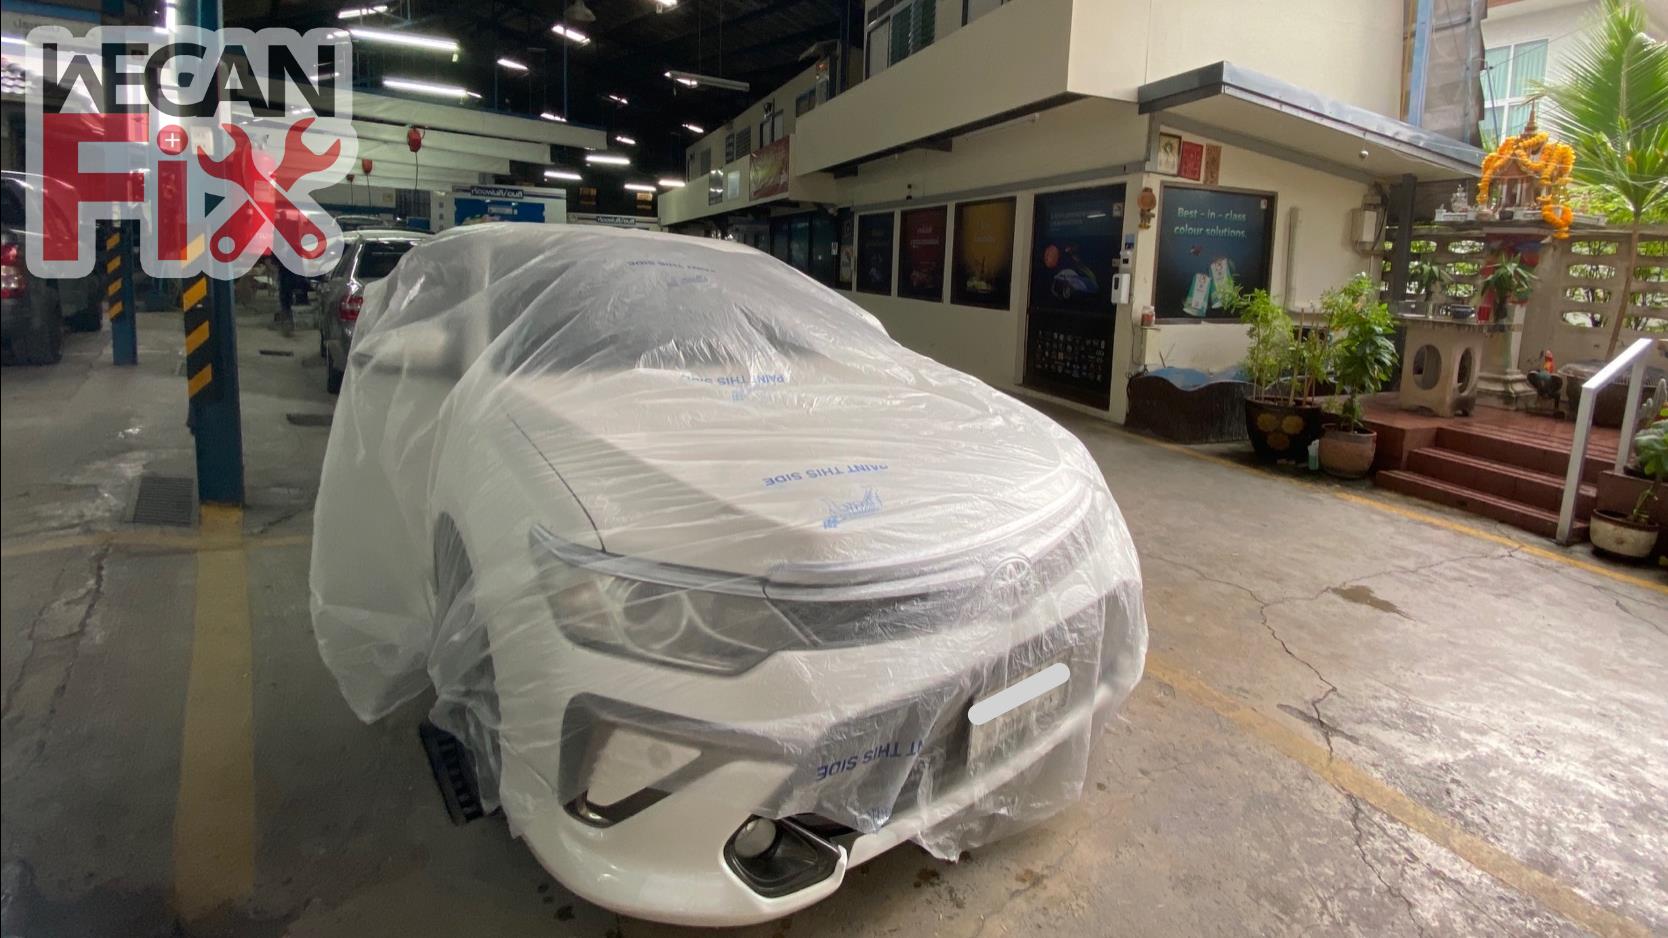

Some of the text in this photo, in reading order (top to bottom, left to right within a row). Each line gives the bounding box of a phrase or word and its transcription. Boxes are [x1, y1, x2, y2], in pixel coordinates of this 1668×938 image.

[1177, 207, 1198, 218] Best
[1225, 210, 1247, 222] class
[1174, 224, 1203, 236] colour
[762, 471, 803, 487] SIDE
[805, 466, 844, 479] THIS
[862, 740, 902, 764] THIS
[815, 755, 859, 782] SIDE
